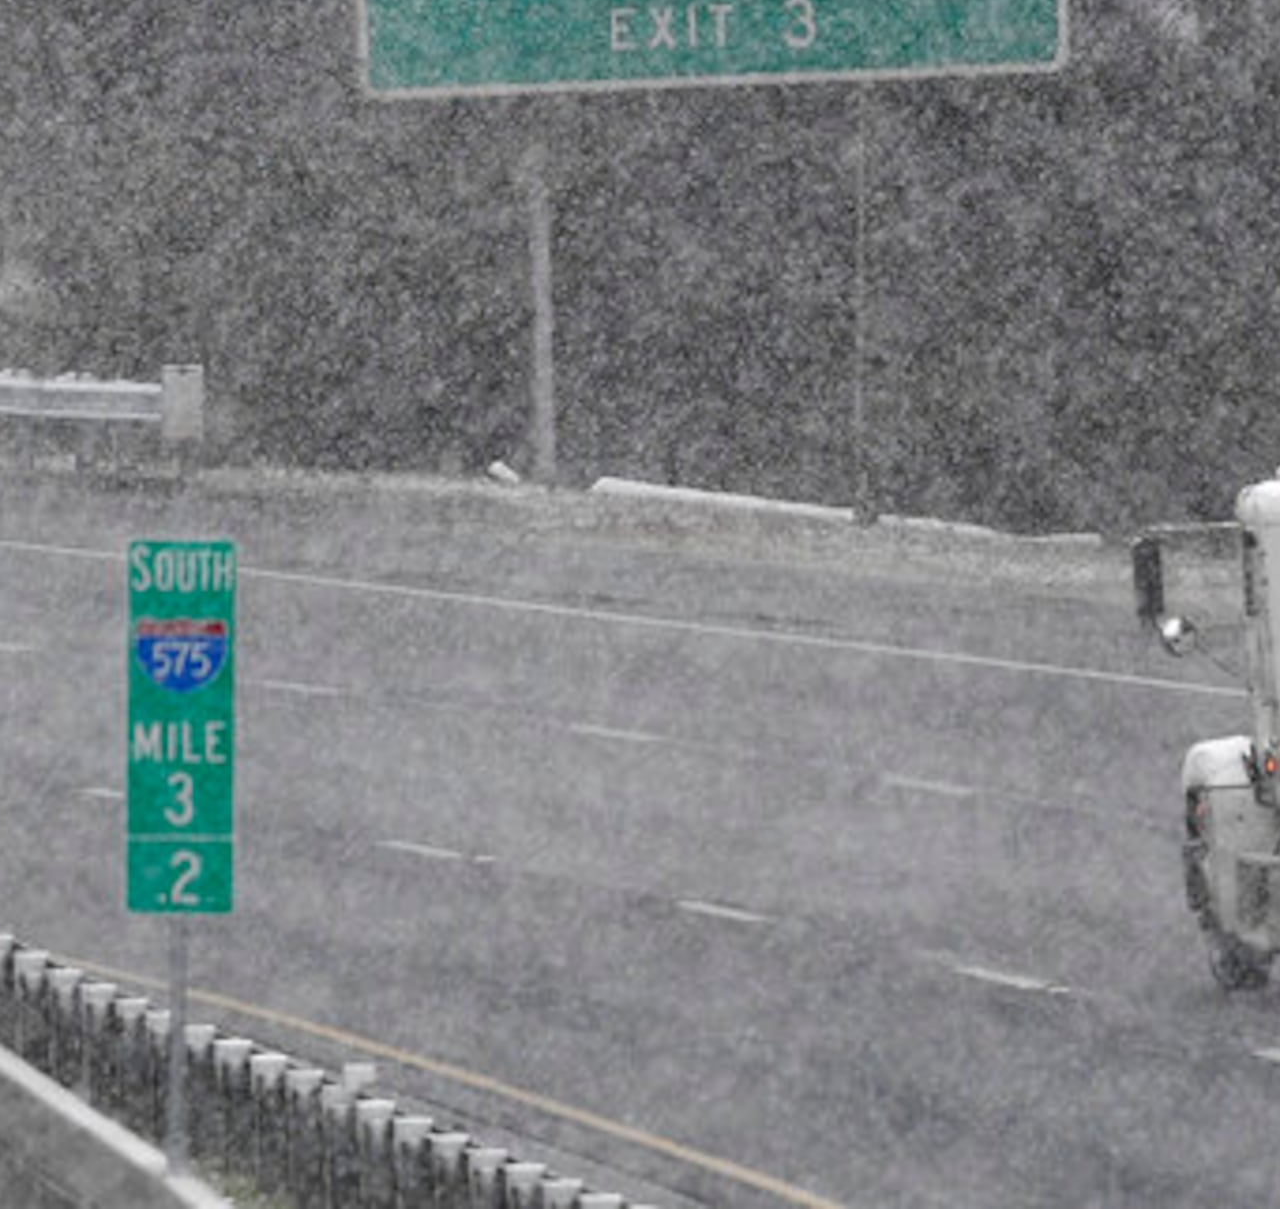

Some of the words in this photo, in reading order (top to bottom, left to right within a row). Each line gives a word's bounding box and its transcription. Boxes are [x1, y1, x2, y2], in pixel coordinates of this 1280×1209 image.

[610, 3, 734, 52] EXIT
[131, 543, 233, 593] SOUTH
[151, 640, 212, 679] 575
[132, 720, 227, 765] MILE
[163, 771, 195, 827] 3
